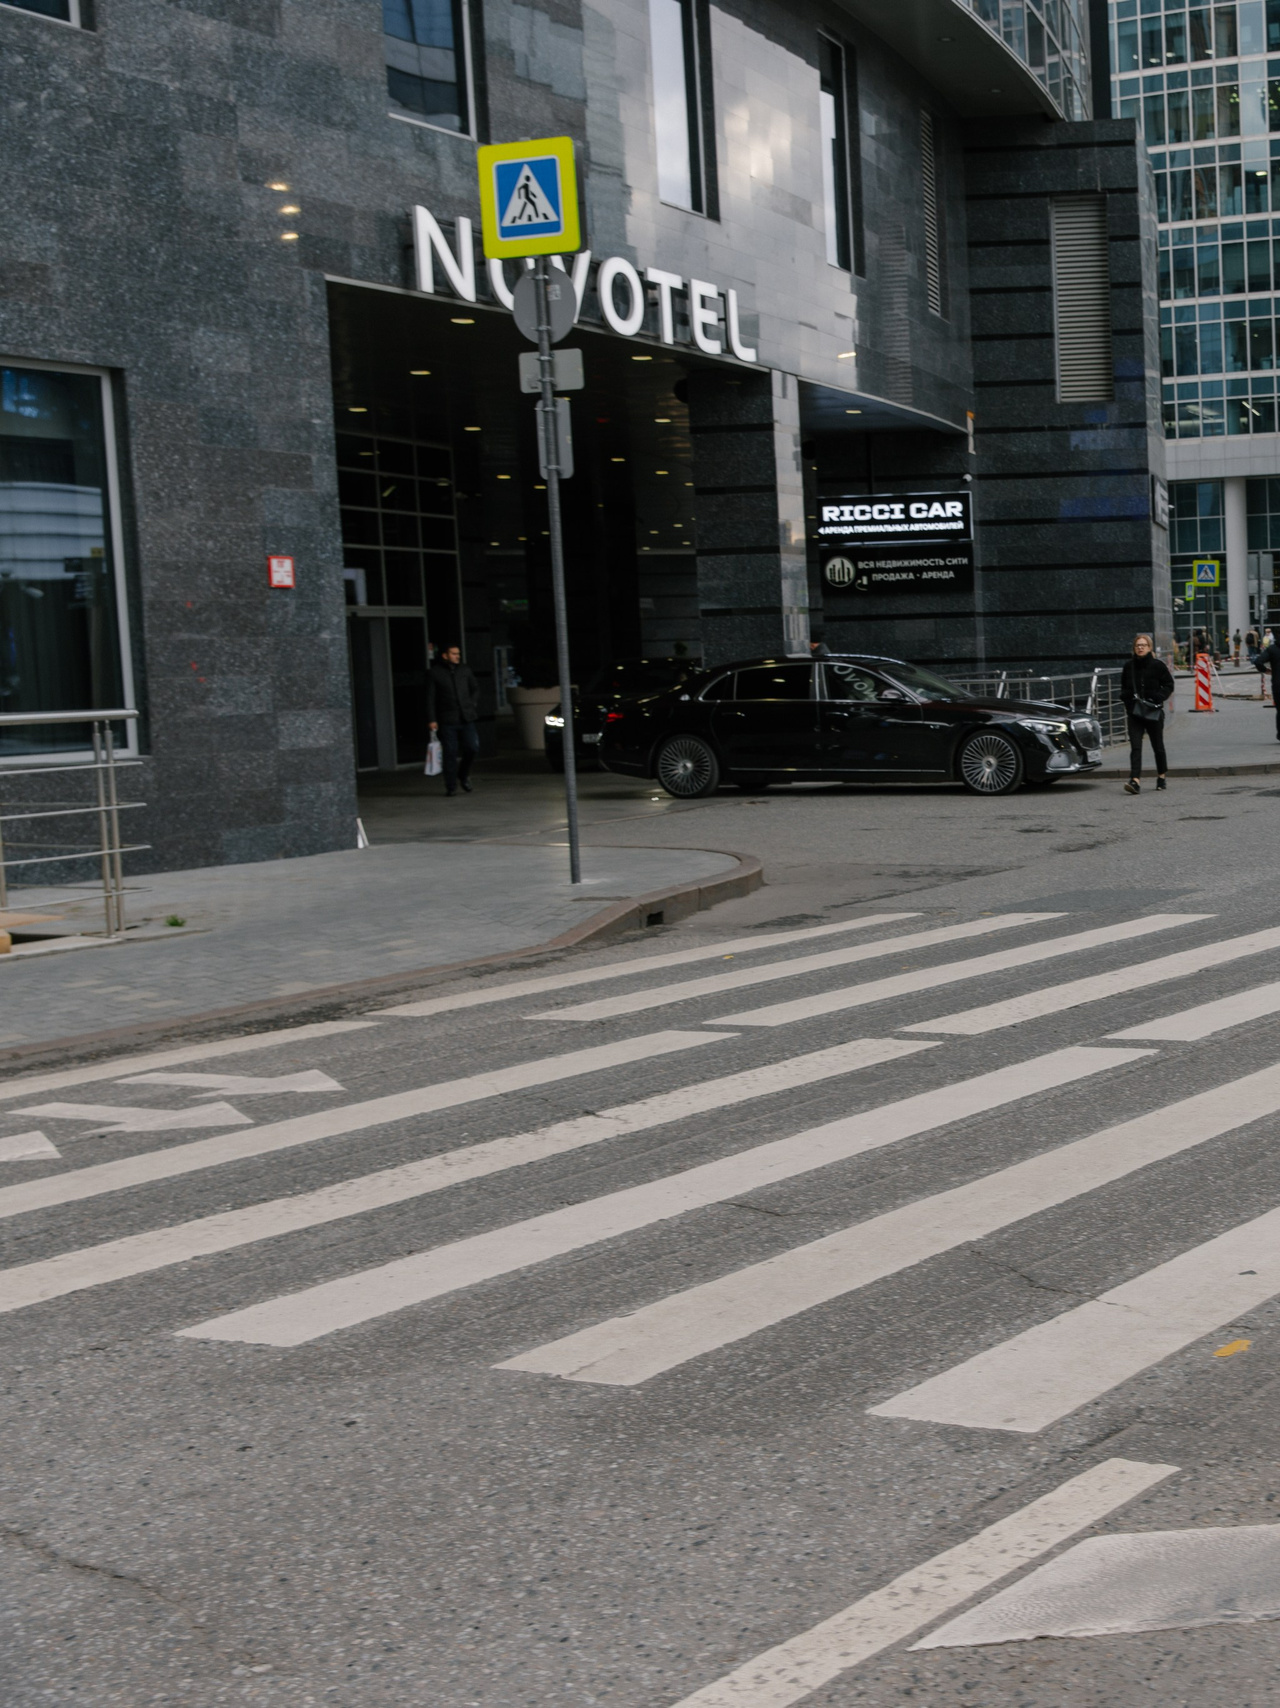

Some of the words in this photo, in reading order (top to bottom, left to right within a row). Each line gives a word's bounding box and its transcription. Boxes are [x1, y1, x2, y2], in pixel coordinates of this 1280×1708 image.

[822, 503, 906, 522] RICCI
[910, 501, 963, 517] CAR
[824, 526, 854, 534] АРЕНДА
[910, 520, 964, 530] АВТОМОБИЛЕЙ
[857, 561, 875, 569] ВСЯ
[876, 558, 945, 568] НЕДВИЖИМОСТЬ
[945, 557, 968, 566] СИТИ
[872, 573, 915, 582] ПРОДАЖА
[921, 571, 955, 580] АРЕНДА
